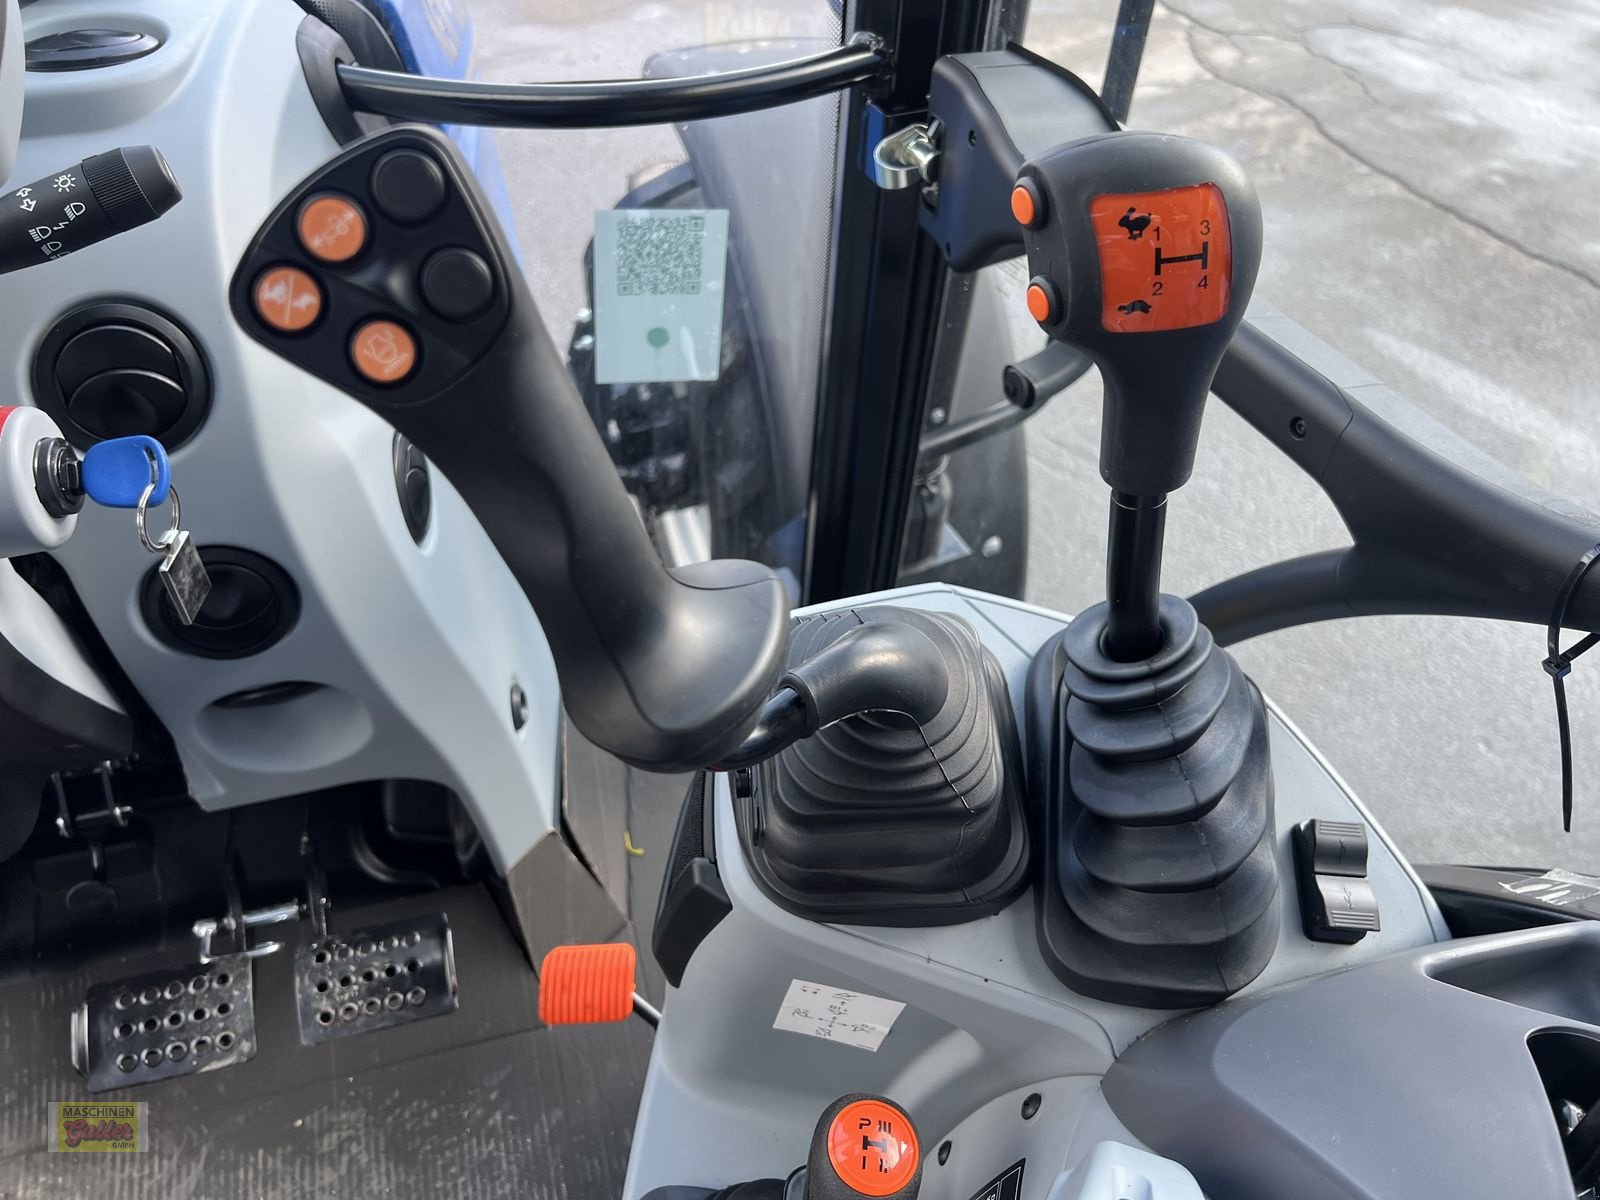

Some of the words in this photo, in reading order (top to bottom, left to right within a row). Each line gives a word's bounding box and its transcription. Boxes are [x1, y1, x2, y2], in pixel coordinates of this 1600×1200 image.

[1152, 226, 1161, 242] 1
[1200, 219, 1211, 236] 3
[1151, 281, 1163, 296] 2
[1197, 275, 1209, 290] 4
[858, 1117, 872, 1130] P
